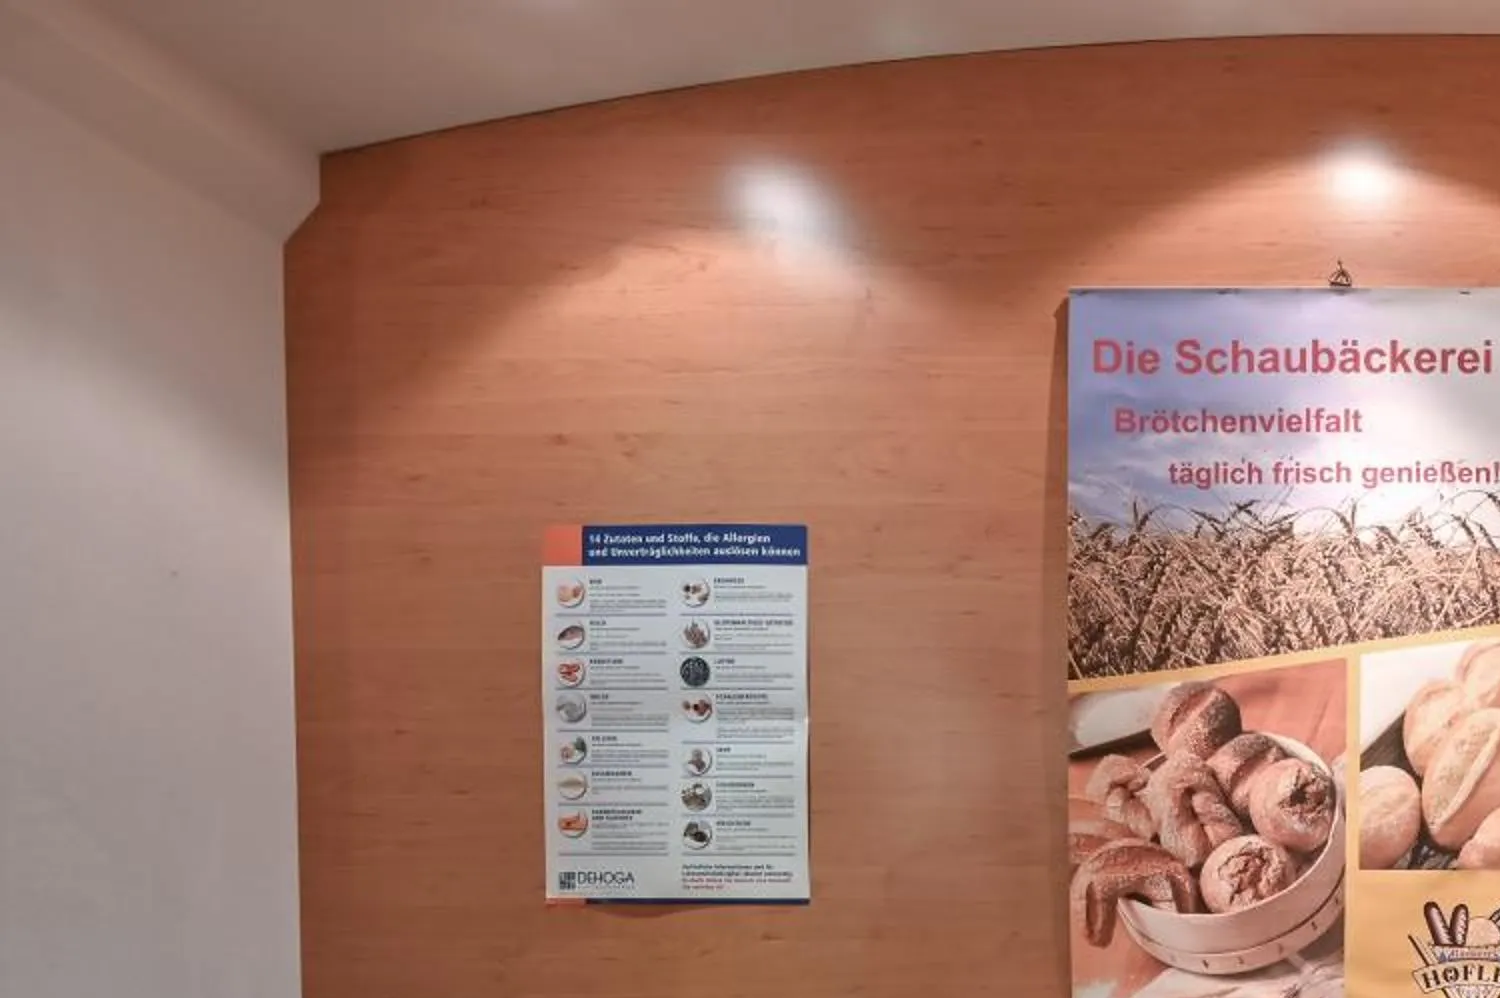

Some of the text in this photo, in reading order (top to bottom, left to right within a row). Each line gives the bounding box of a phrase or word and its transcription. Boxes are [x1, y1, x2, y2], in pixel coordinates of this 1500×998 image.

[1092, 338, 1493, 375] Die Schaubäckerei
[1114, 407, 1363, 434] Brötchenvielfalt
[1168, 460, 1500, 490] täglich frisch genießen!
[645, 533, 665, 543] und
[703, 532, 720, 543] die
[723, 532, 771, 545] Allergien
[577, 871, 635, 885] DEHOGA
